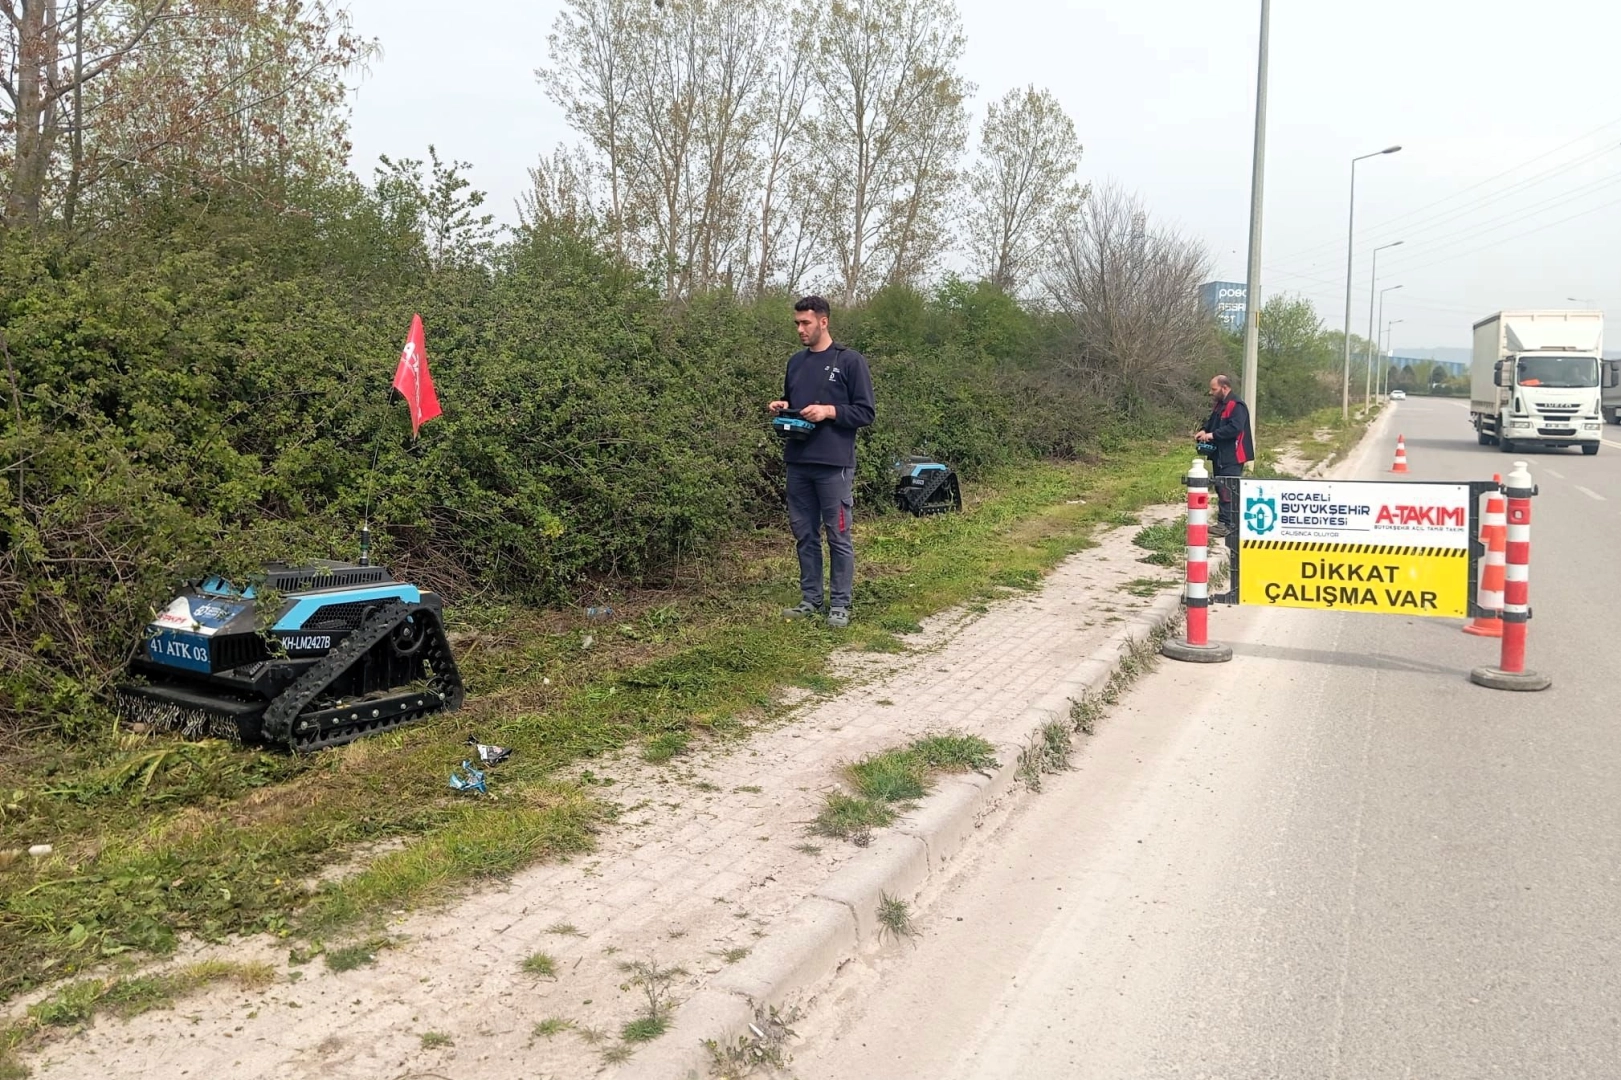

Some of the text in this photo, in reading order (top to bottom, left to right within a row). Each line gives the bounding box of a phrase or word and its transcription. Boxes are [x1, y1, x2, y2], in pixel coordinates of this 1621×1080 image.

[1281, 503, 1371, 516] BÜYÜKŞEHİR
[1281, 515, 1348, 526] BELEDİYESİ
[1375, 505, 1465, 527] A-TAKIMI
[1301, 558, 1400, 584] DİKKAT
[1264, 582, 1438, 610] ÇALIŞMA VAR
[150, 638, 208, 662] 41 ATK 03
[282, 635, 331, 650] KH-LM2427B
